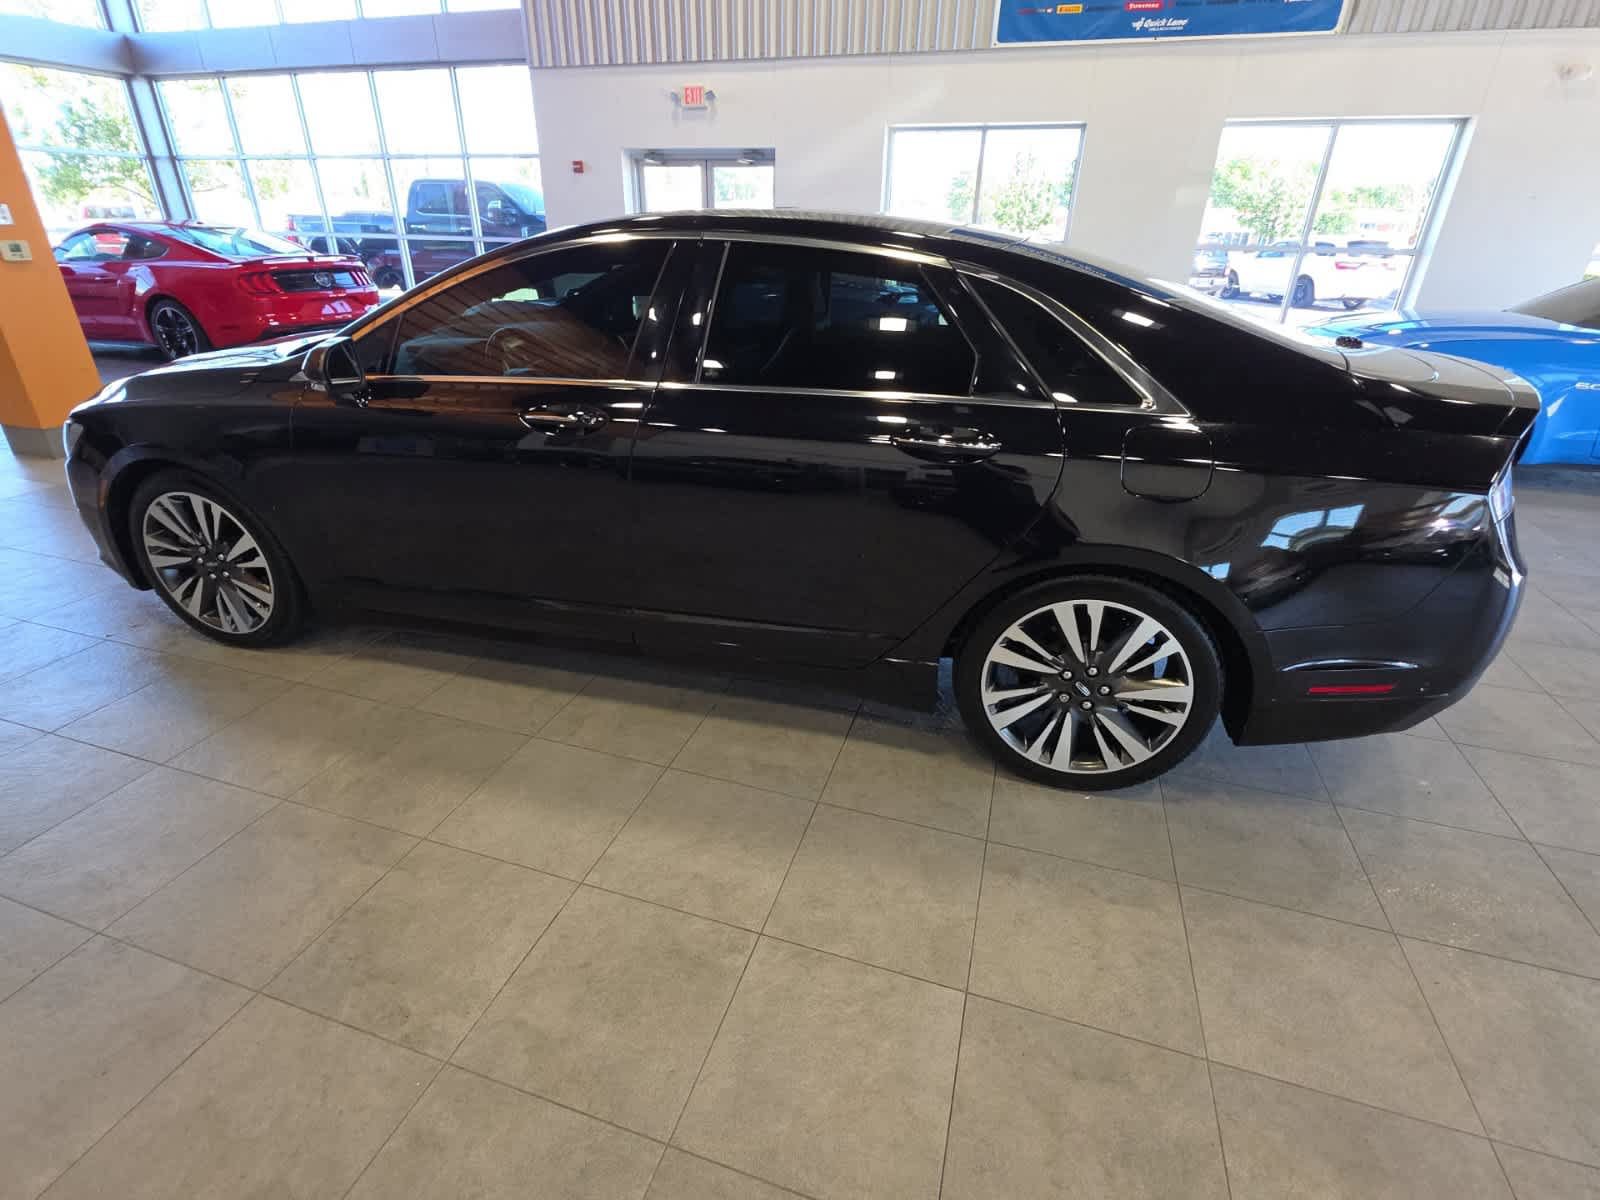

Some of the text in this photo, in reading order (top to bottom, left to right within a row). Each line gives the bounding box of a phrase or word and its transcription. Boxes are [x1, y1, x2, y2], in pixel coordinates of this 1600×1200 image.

[1143, 18, 1189, 28] Quick Lane
[684, 87, 704, 105] EXIT
